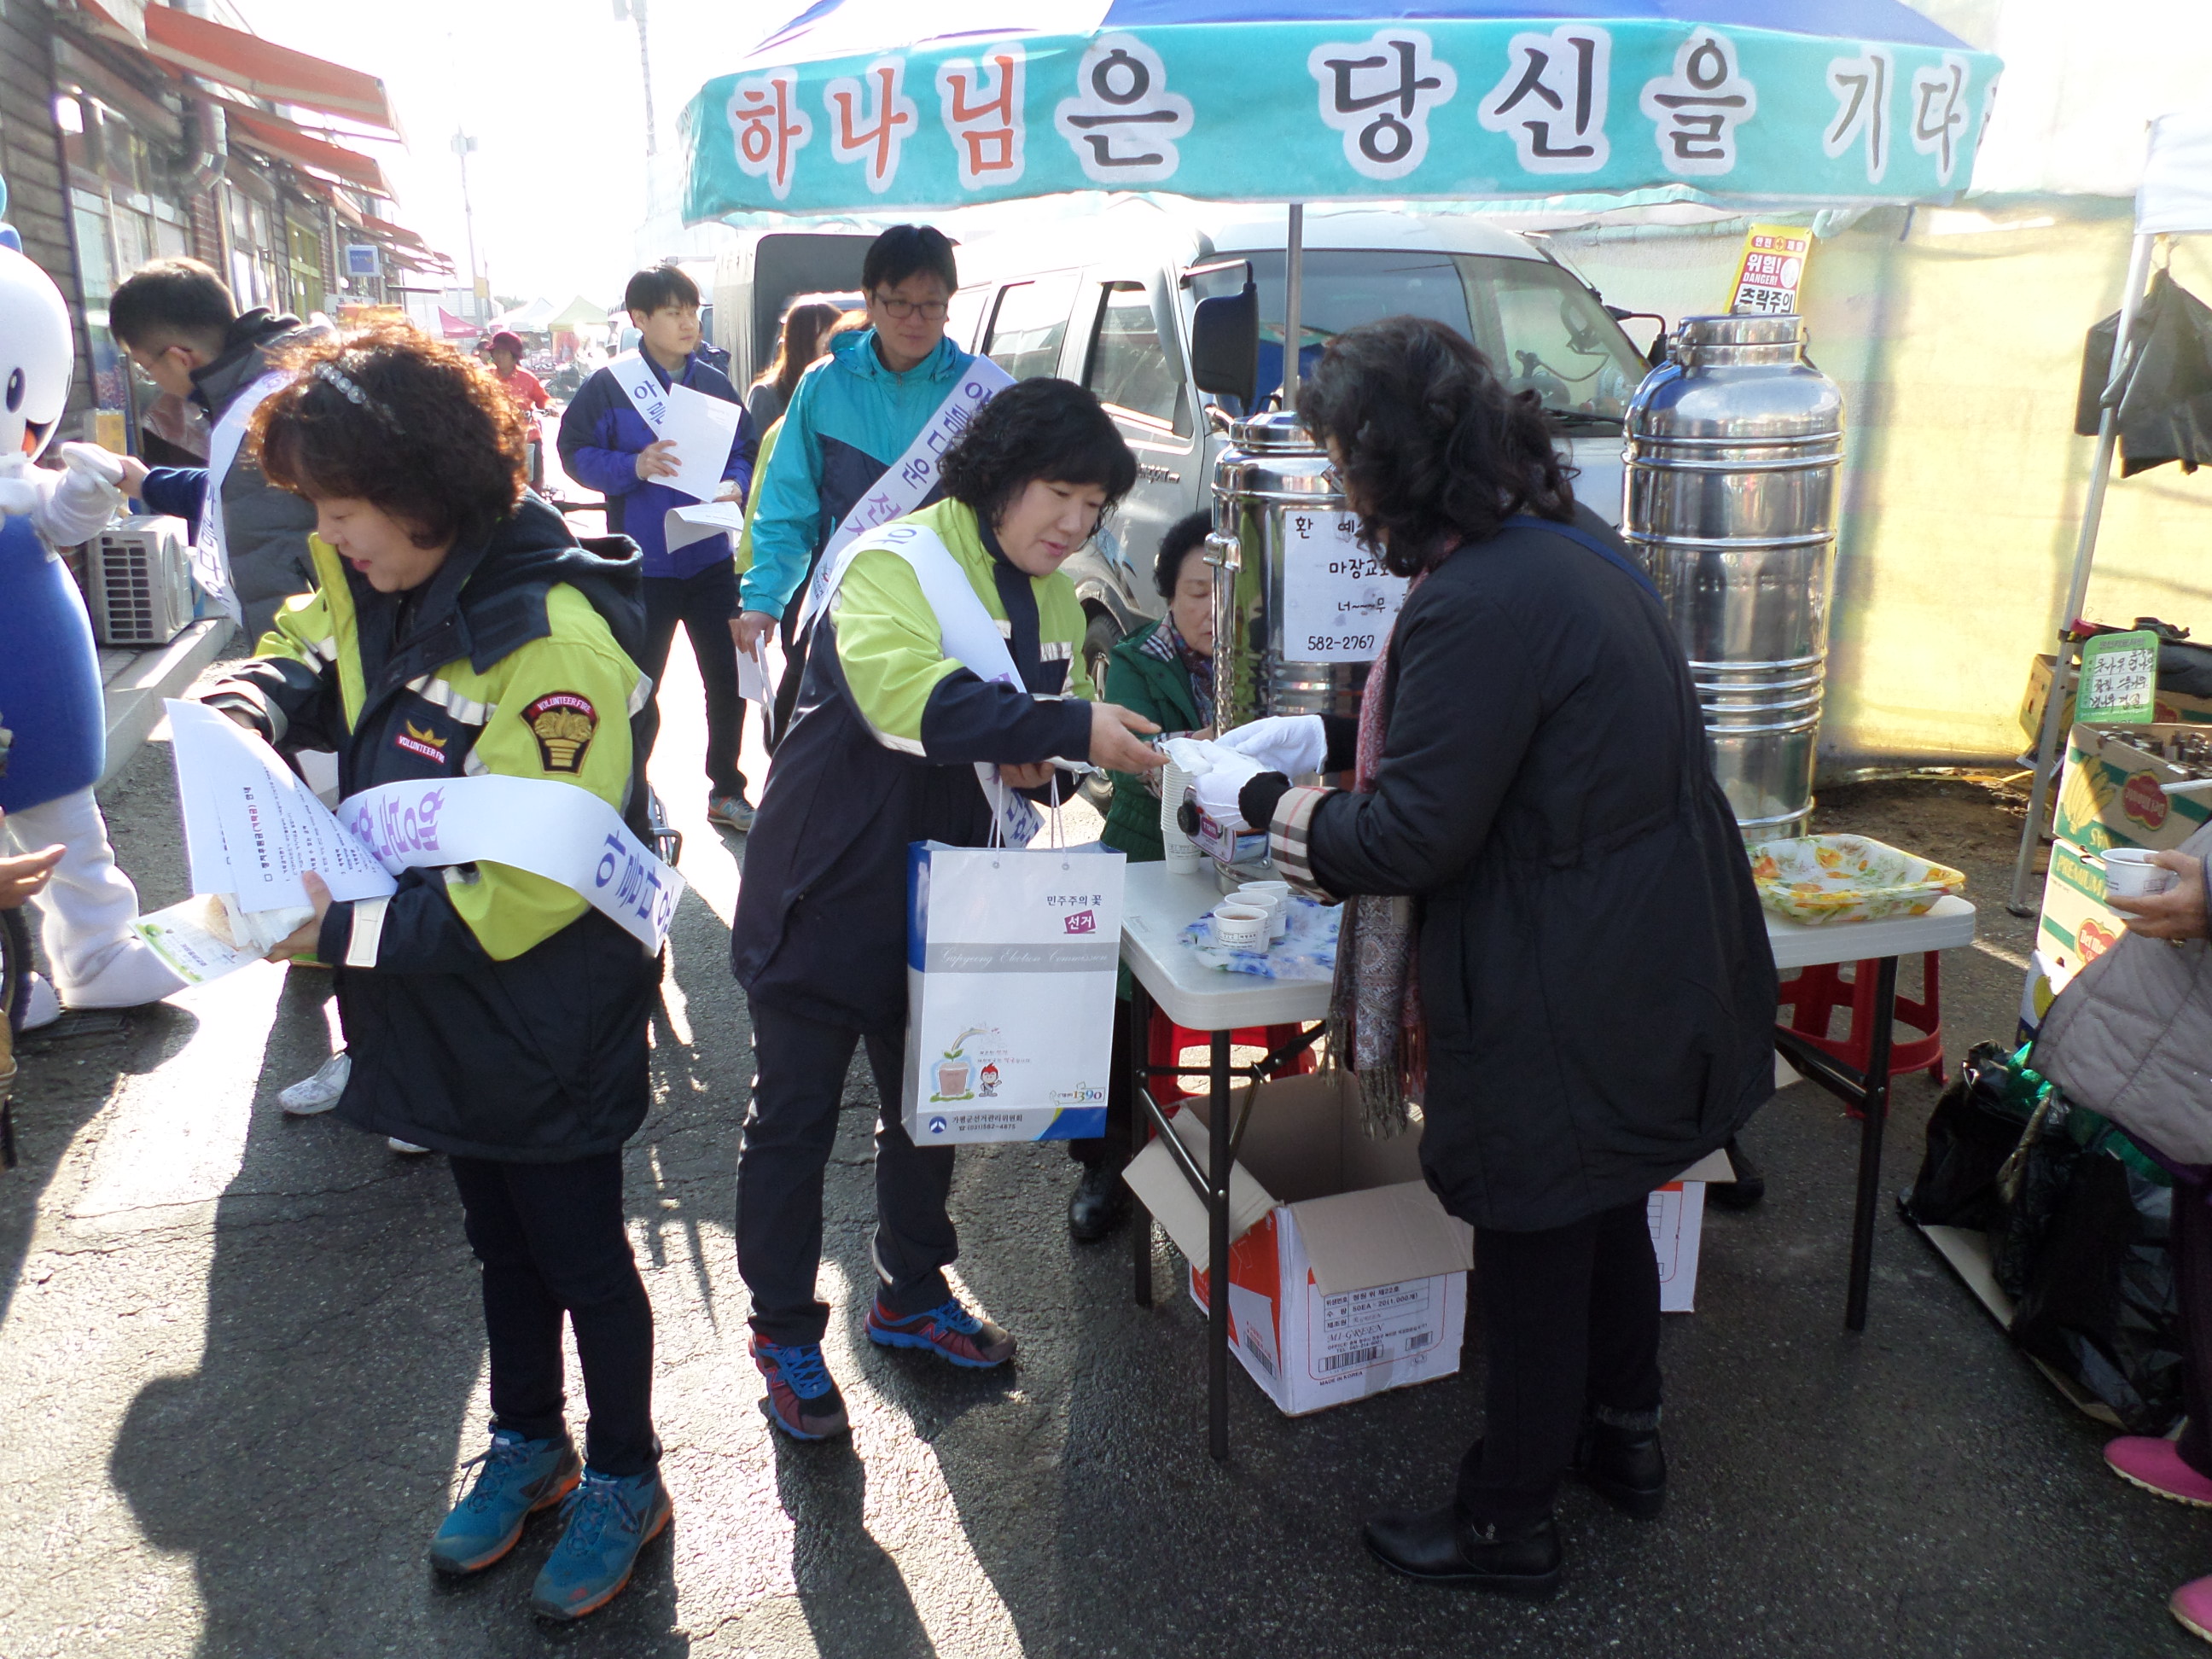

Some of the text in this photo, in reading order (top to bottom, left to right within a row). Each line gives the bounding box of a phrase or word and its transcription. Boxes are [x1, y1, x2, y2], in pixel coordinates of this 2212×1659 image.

[734, 37, 1999, 187] 하나님은 당신을 기다
[1747, 253, 1783, 274] 위험!
[1743, 271, 1778, 286] DANGER!
[1739, 288, 1794, 314] 추락주의
[1337, 519, 1363, 534] 예
[1307, 634, 1375, 650] 582-2767
[538, 696, 591, 713] VOLUNTEER FIRE
[399, 736, 437, 756] VOLUNTEER
[1046, 894, 1102, 906] 민주주의 꽃
[1068, 916, 1092, 930] 선거
[1074, 1090, 1103, 1103] 1390
[1319, 1377, 1335, 1386] MADE
[1343, 1371, 1363, 1380] KOREA
